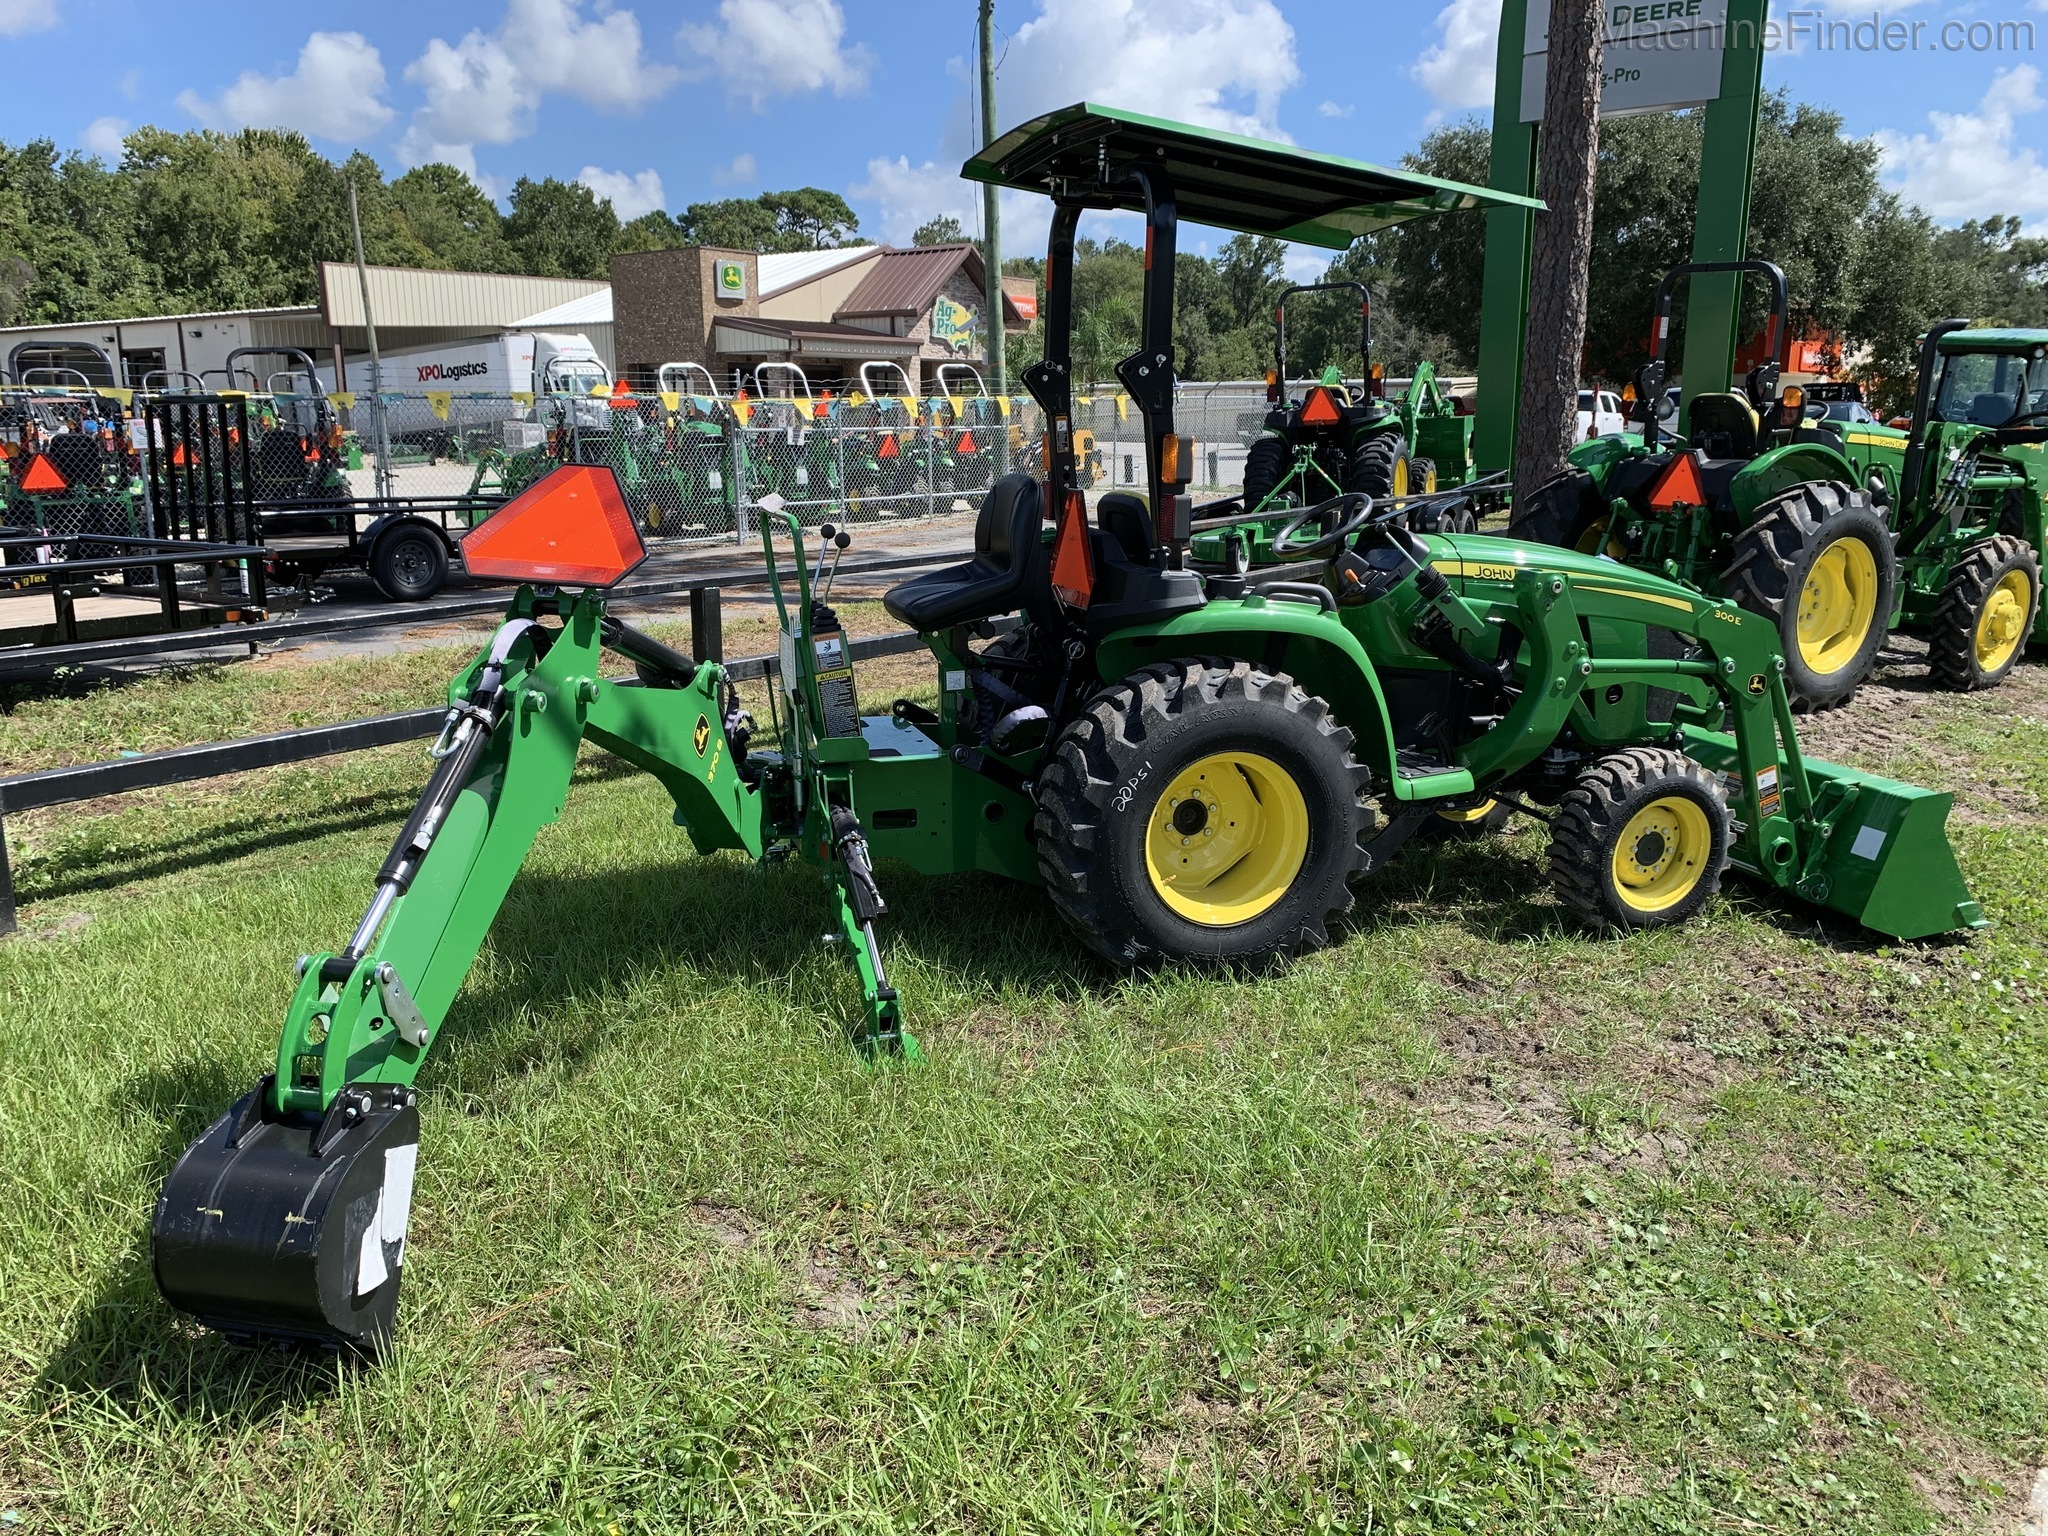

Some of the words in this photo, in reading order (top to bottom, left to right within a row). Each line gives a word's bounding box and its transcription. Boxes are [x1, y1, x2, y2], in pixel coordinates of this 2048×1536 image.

[1612, 0, 1701, 27] DEERE
[1600, 67, 1641, 89] g-Pro
[937, 301, 957, 321] Ag-
[936, 318, 957, 335] Pro
[1475, 565, 1513, 579] JOHN
[825, 670, 848, 680] CAUTION
